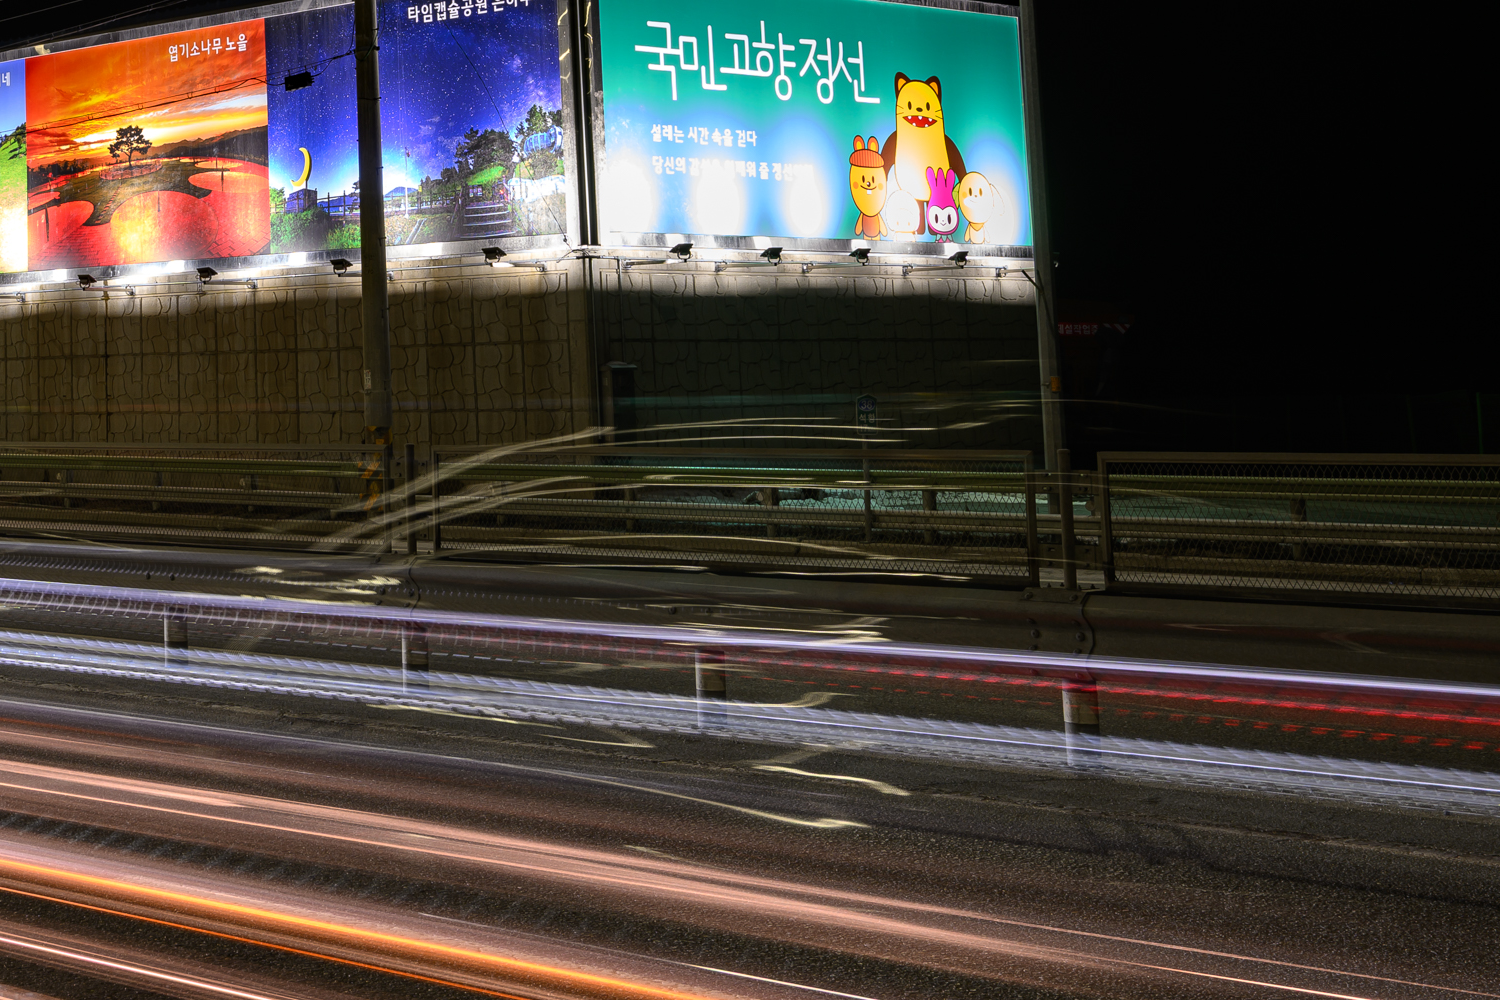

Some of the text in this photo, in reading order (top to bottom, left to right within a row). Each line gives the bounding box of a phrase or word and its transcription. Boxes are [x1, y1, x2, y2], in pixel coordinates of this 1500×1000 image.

[168, 33, 248, 62] 엽기소나무 노을
[650, 124, 757, 148] 설레는 시간 속을 걷다
[651, 155, 687, 175] 당신의
[758, 162, 770, 180] 줄
[860, 400, 873, 410] 38
